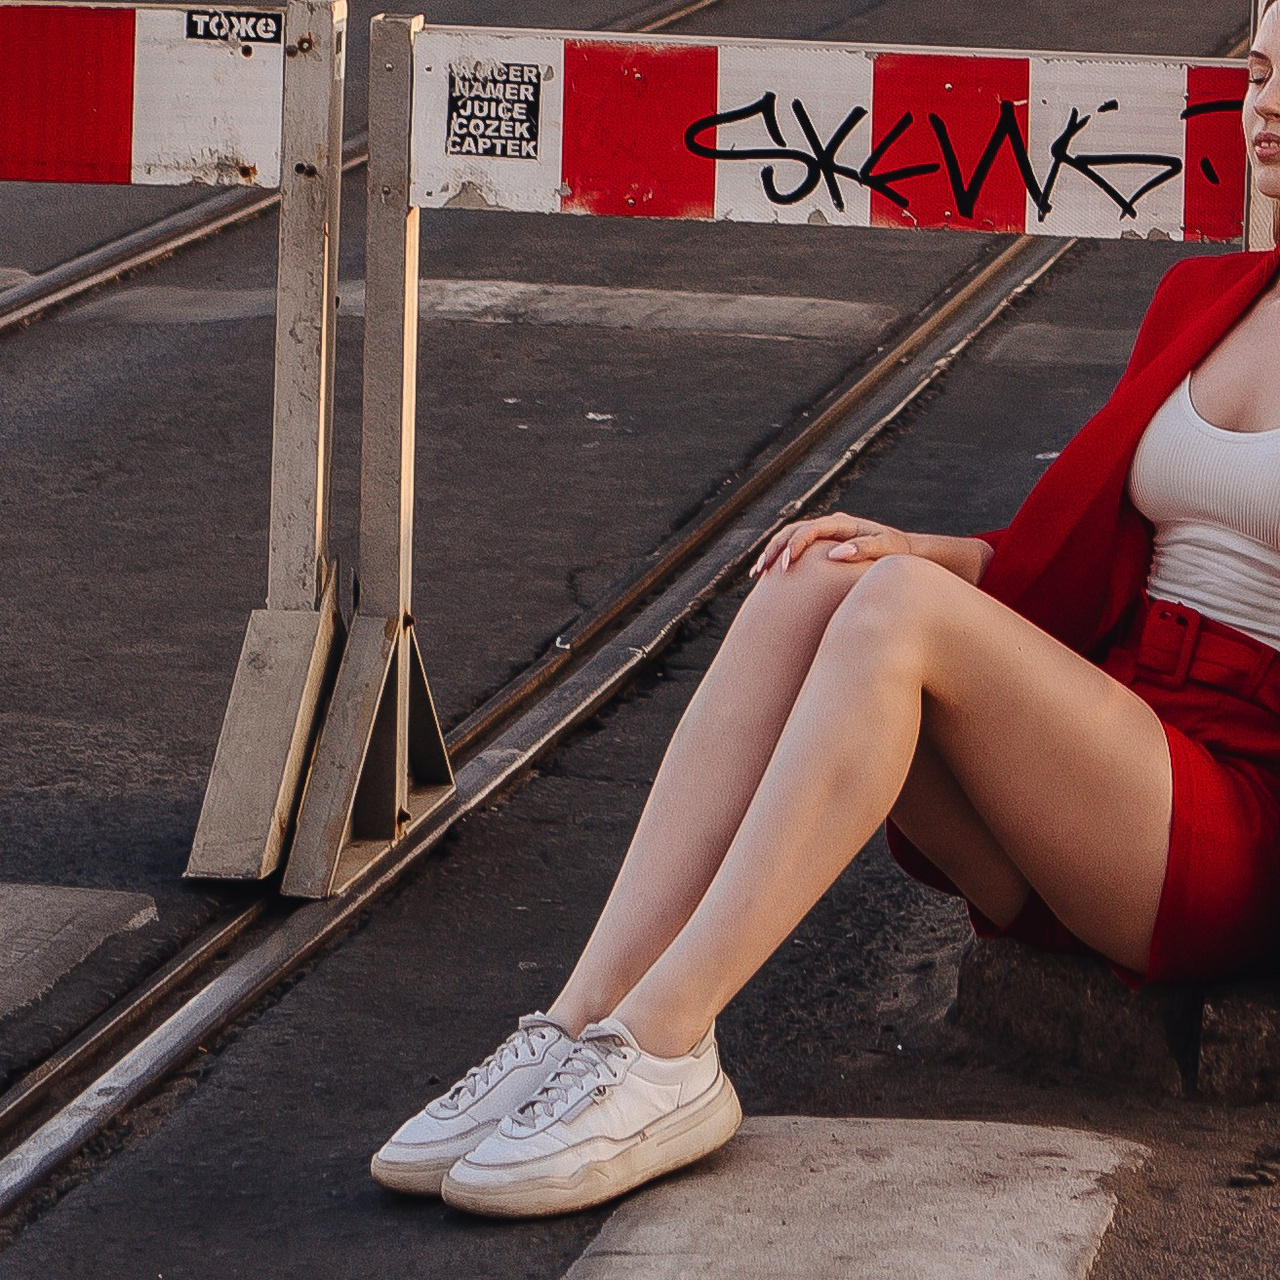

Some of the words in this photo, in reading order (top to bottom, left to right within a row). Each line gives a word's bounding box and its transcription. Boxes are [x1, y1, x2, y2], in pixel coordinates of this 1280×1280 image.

[452, 80, 535, 102] NAMER
[458, 100, 528, 120] JUICE
[453, 118, 531, 139] COZEK
[448, 137, 538, 157] CAPTEK
